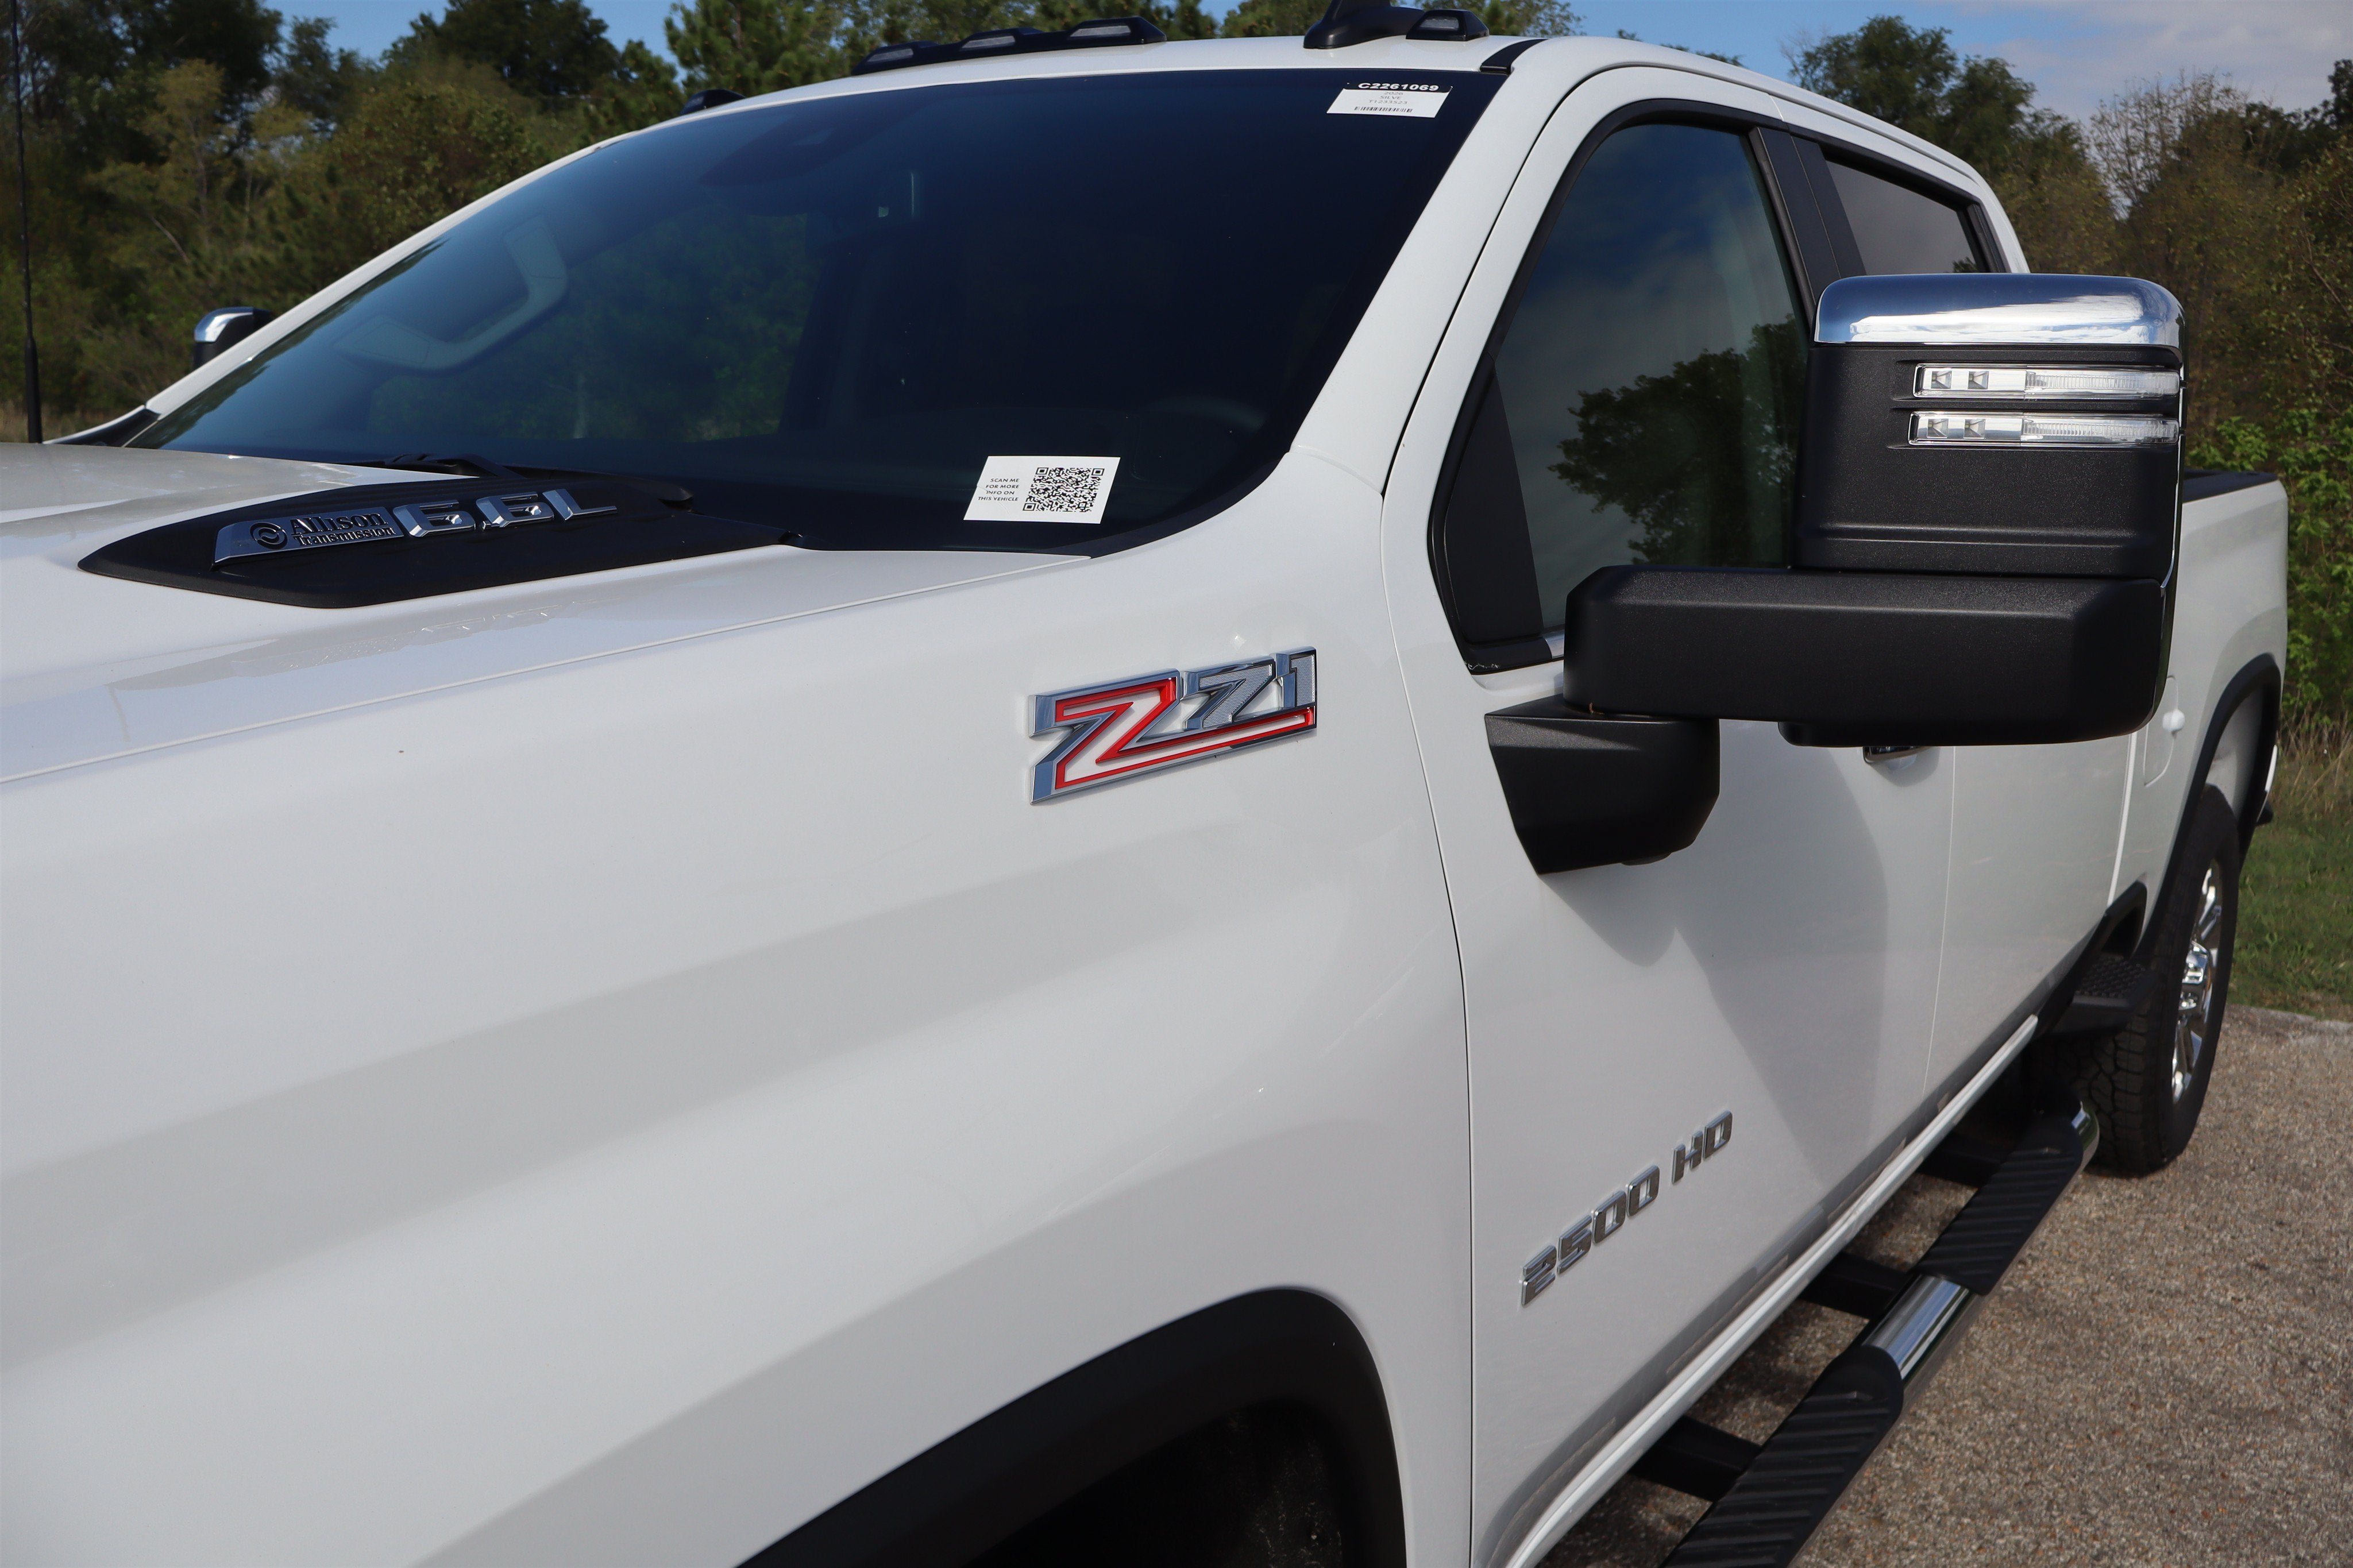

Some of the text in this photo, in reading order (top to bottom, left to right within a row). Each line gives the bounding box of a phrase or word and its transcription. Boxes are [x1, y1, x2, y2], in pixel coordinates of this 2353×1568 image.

[1358, 83, 1439, 91] C2261069
[290, 512, 388, 536] Allison
[393, 489, 618, 538] 6.6L
[293, 526, 396, 546] Transmission
[1029, 646, 1317, 805] Z71
[1521, 1110, 1733, 1307] 2500 HD
